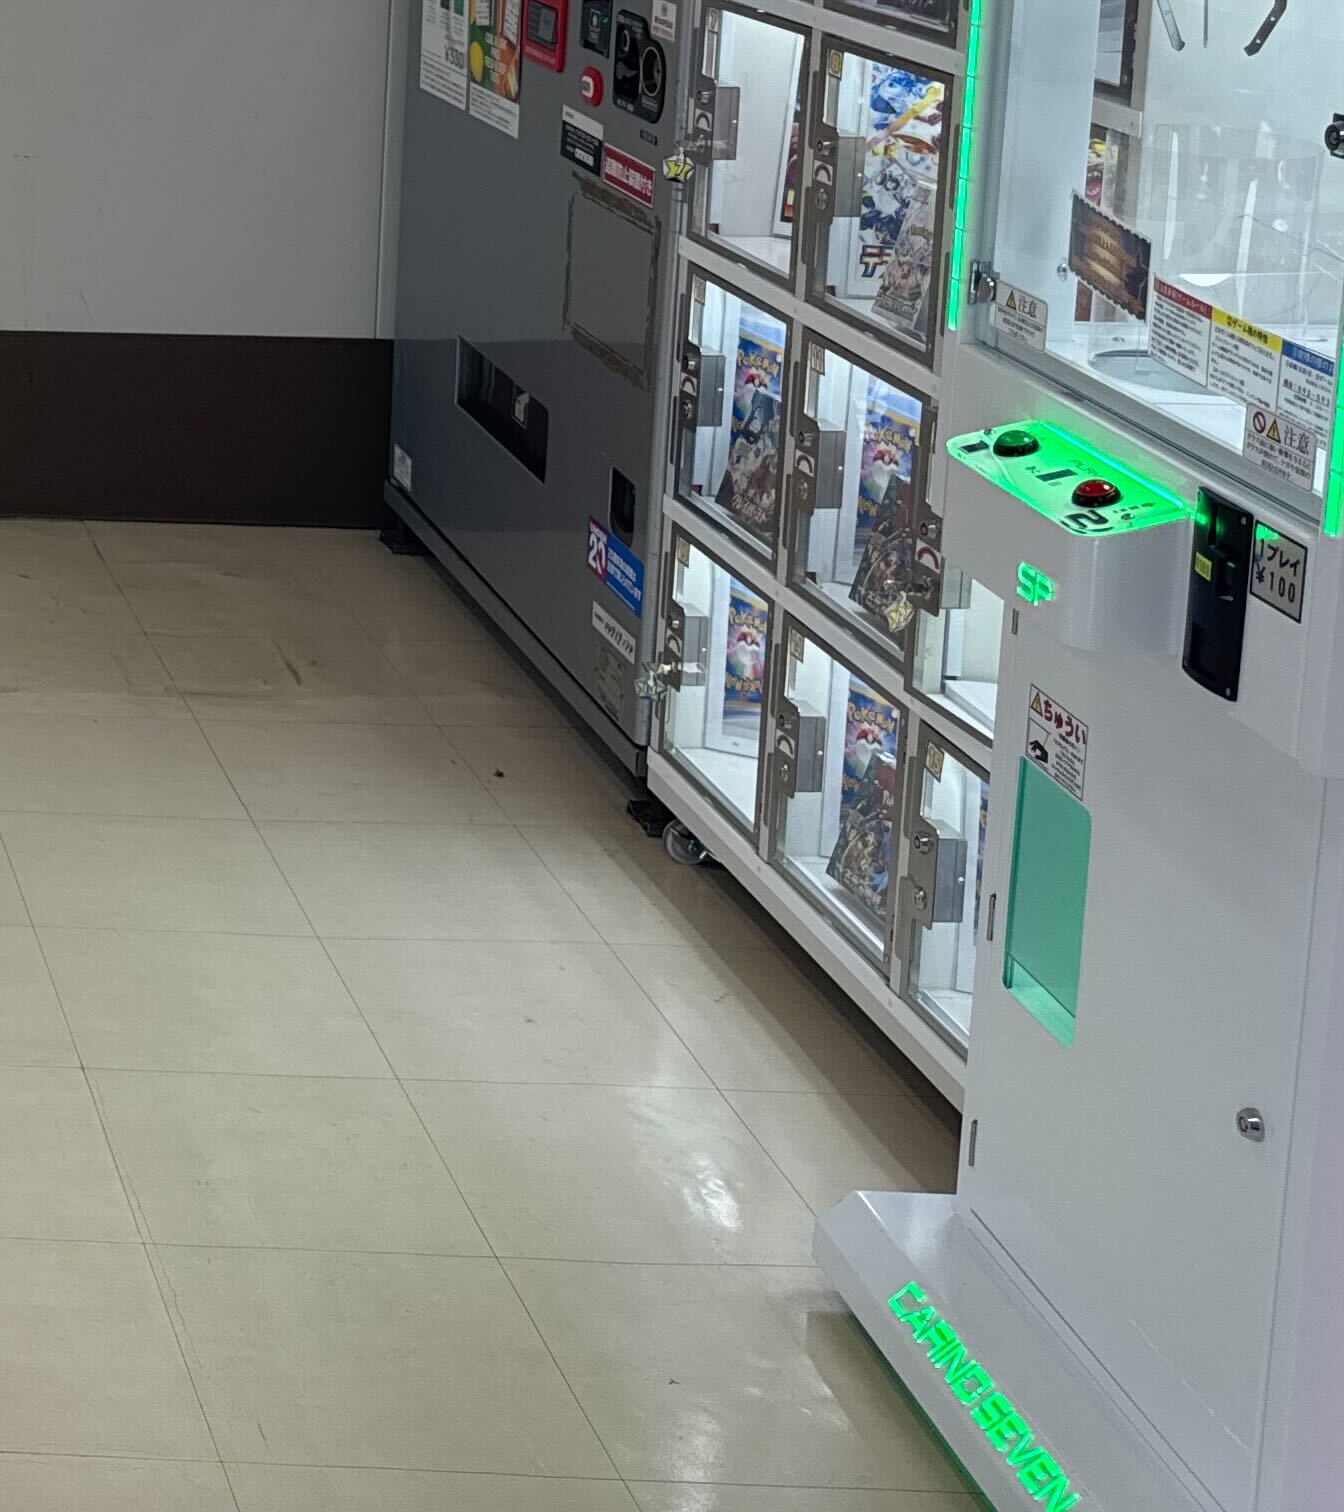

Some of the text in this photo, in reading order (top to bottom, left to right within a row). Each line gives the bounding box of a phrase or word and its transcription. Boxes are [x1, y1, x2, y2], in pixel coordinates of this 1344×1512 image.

[1017, 294, 1038, 319] 注意
[1283, 424, 1311, 456] 注意
[1255, 562, 1297, 604] ¥100
[1043, 699, 1087, 744] ちゅうい
[888, 1281, 995, 1405] CARINO
